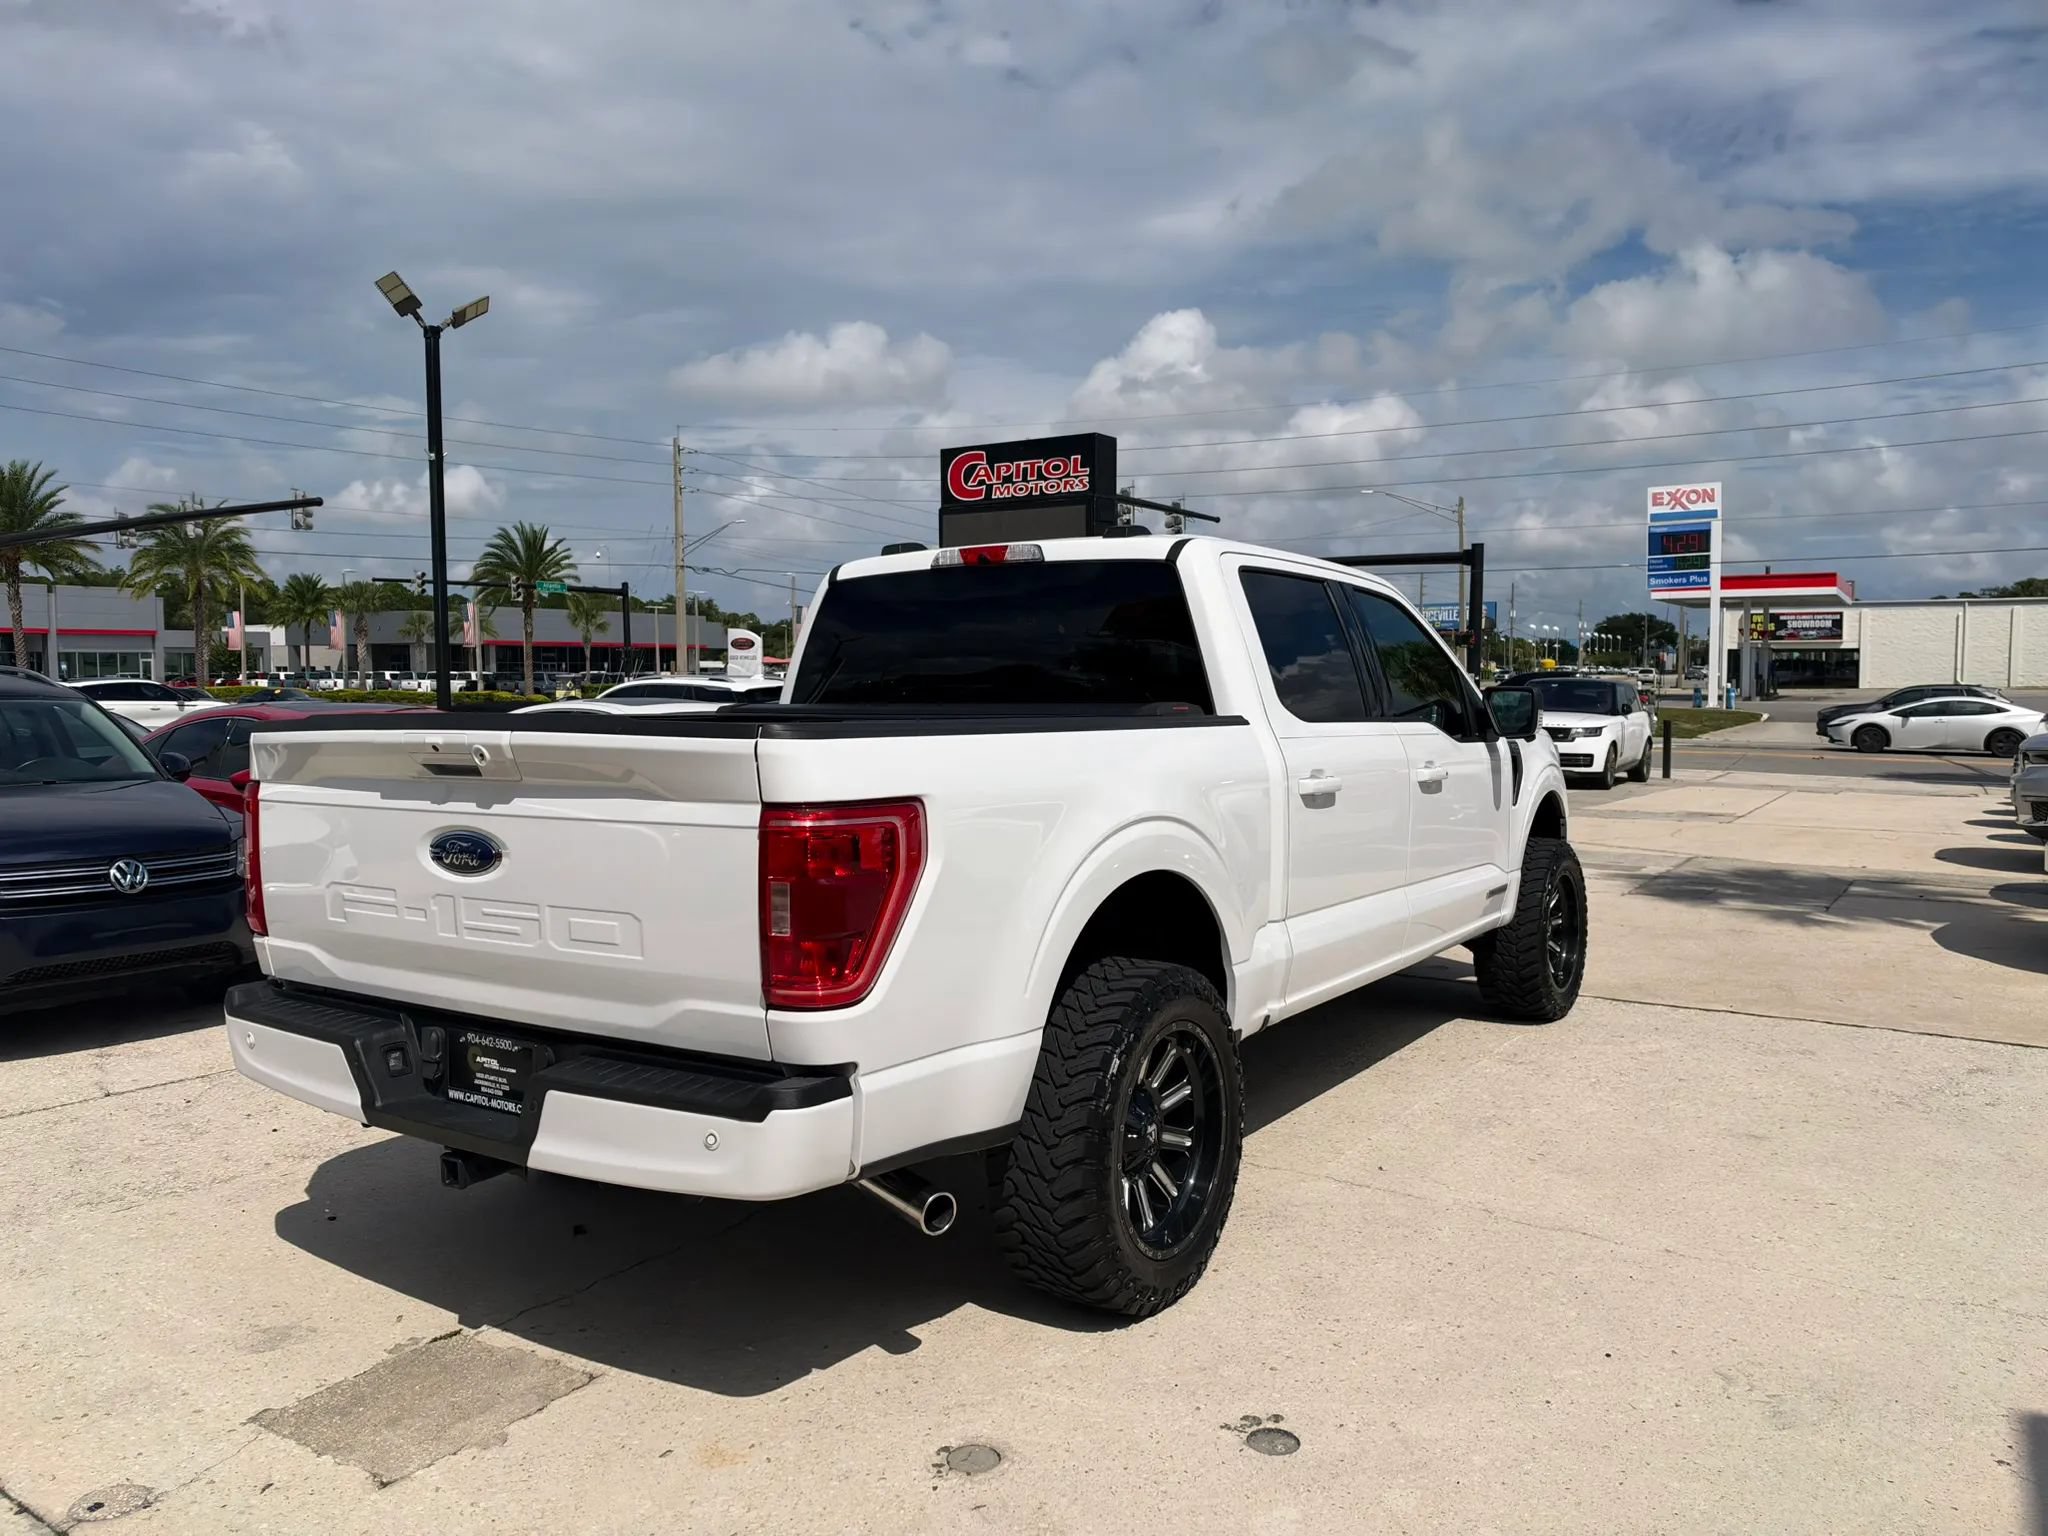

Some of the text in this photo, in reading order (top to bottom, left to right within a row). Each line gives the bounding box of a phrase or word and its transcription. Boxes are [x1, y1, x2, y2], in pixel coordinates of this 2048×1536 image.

[947, 451, 1090, 501] CAPITOL
[992, 476, 1090, 499] MOTORS
[1652, 488, 1716, 510] EXXON
[1649, 575, 1708, 585] Smokers Plus
[1787, 619, 1832, 628] SHOWROOM
[442, 840, 481, 868] Ford
[326, 881, 644, 960] F-150
[466, 1032, 513, 1051] 904-642-5500
